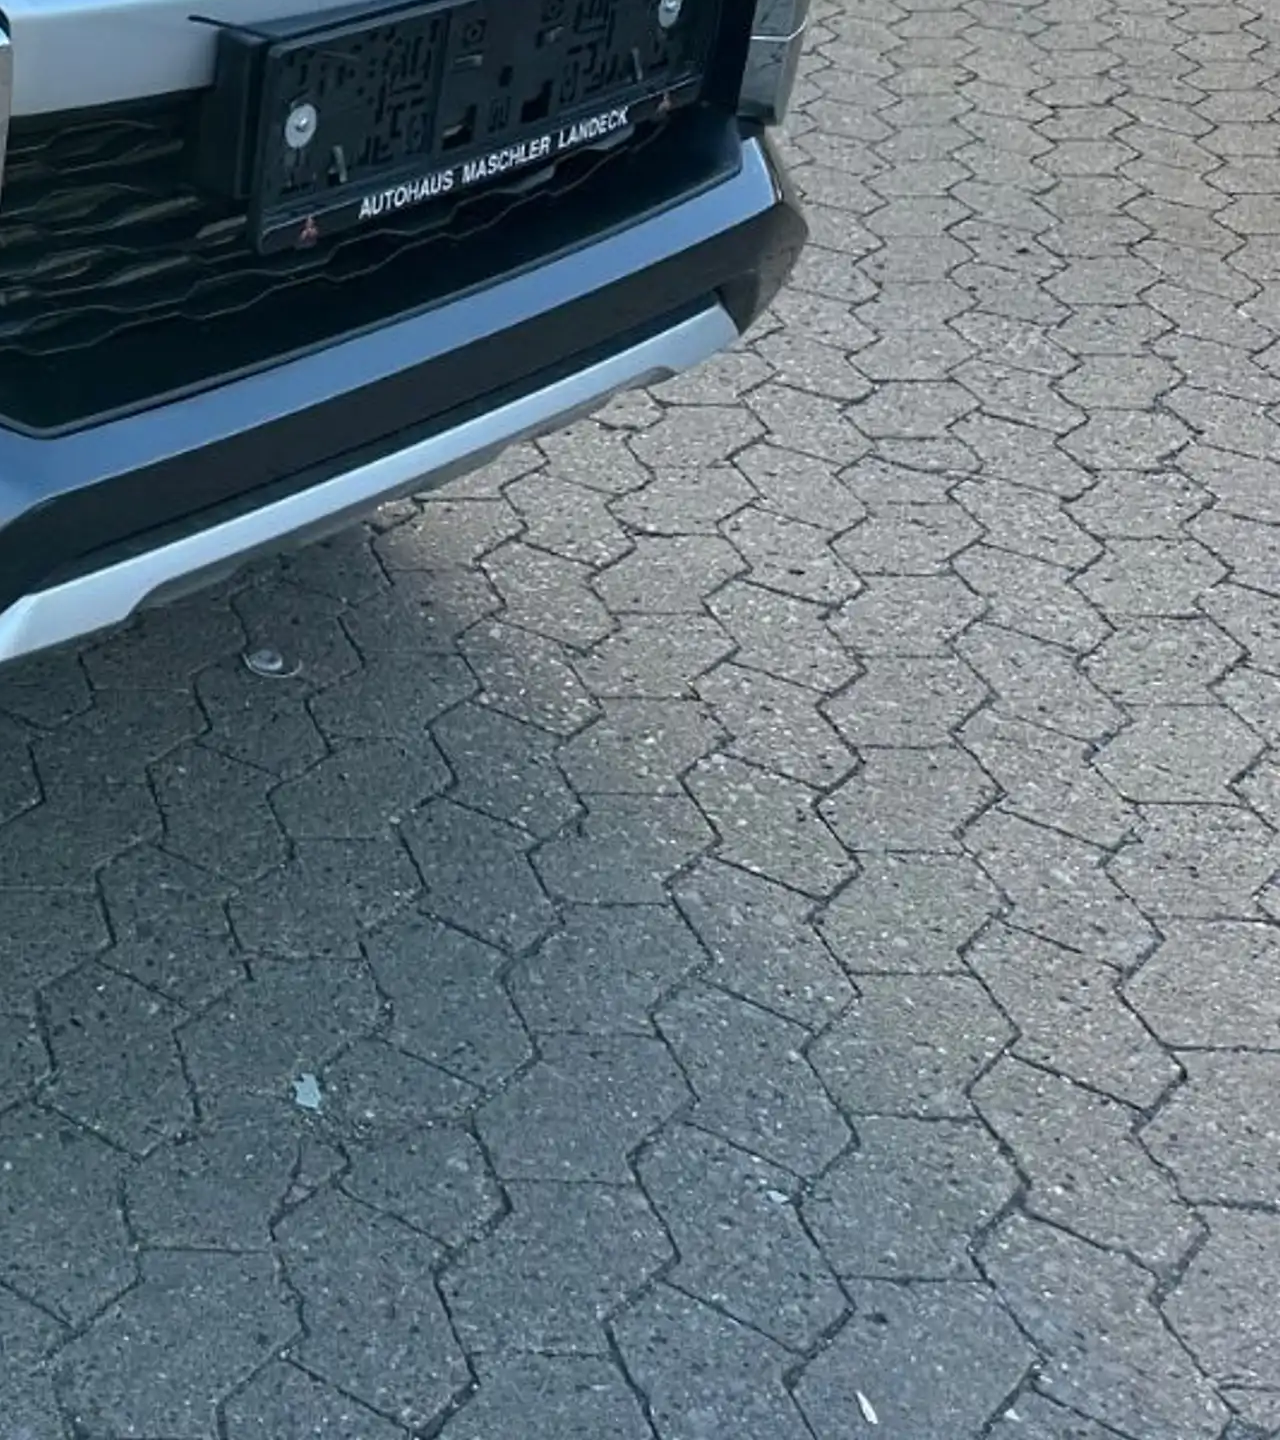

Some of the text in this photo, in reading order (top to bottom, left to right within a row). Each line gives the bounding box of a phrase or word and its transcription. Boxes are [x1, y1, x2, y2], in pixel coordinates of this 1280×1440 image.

[359, 107, 629, 219] AUTOHAUS MASCHLER LANDECK
